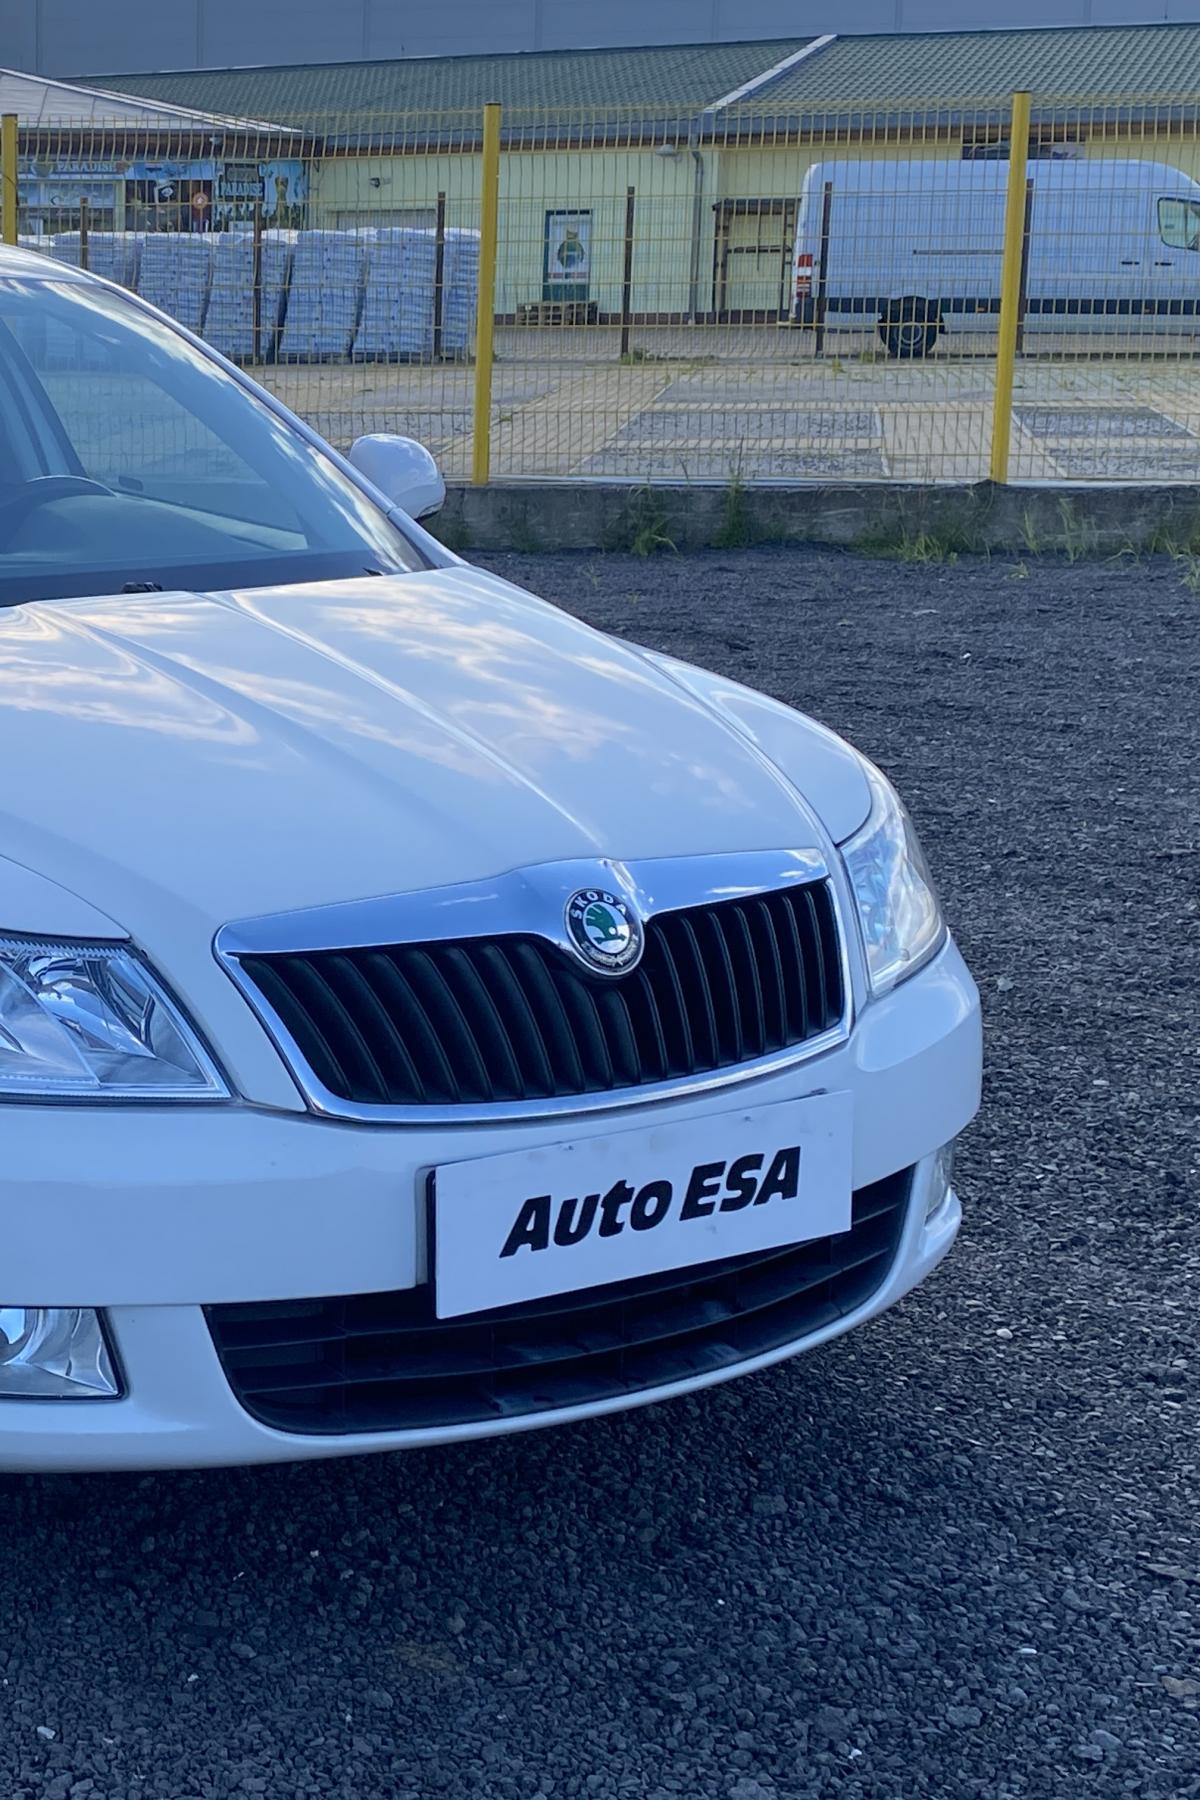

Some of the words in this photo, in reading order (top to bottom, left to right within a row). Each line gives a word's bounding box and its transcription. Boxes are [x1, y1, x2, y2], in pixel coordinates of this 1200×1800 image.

[220, 182, 264, 197] PARADISE
[499, 1179, 673, 1259] Auto
[679, 1145, 801, 1222] ESA
